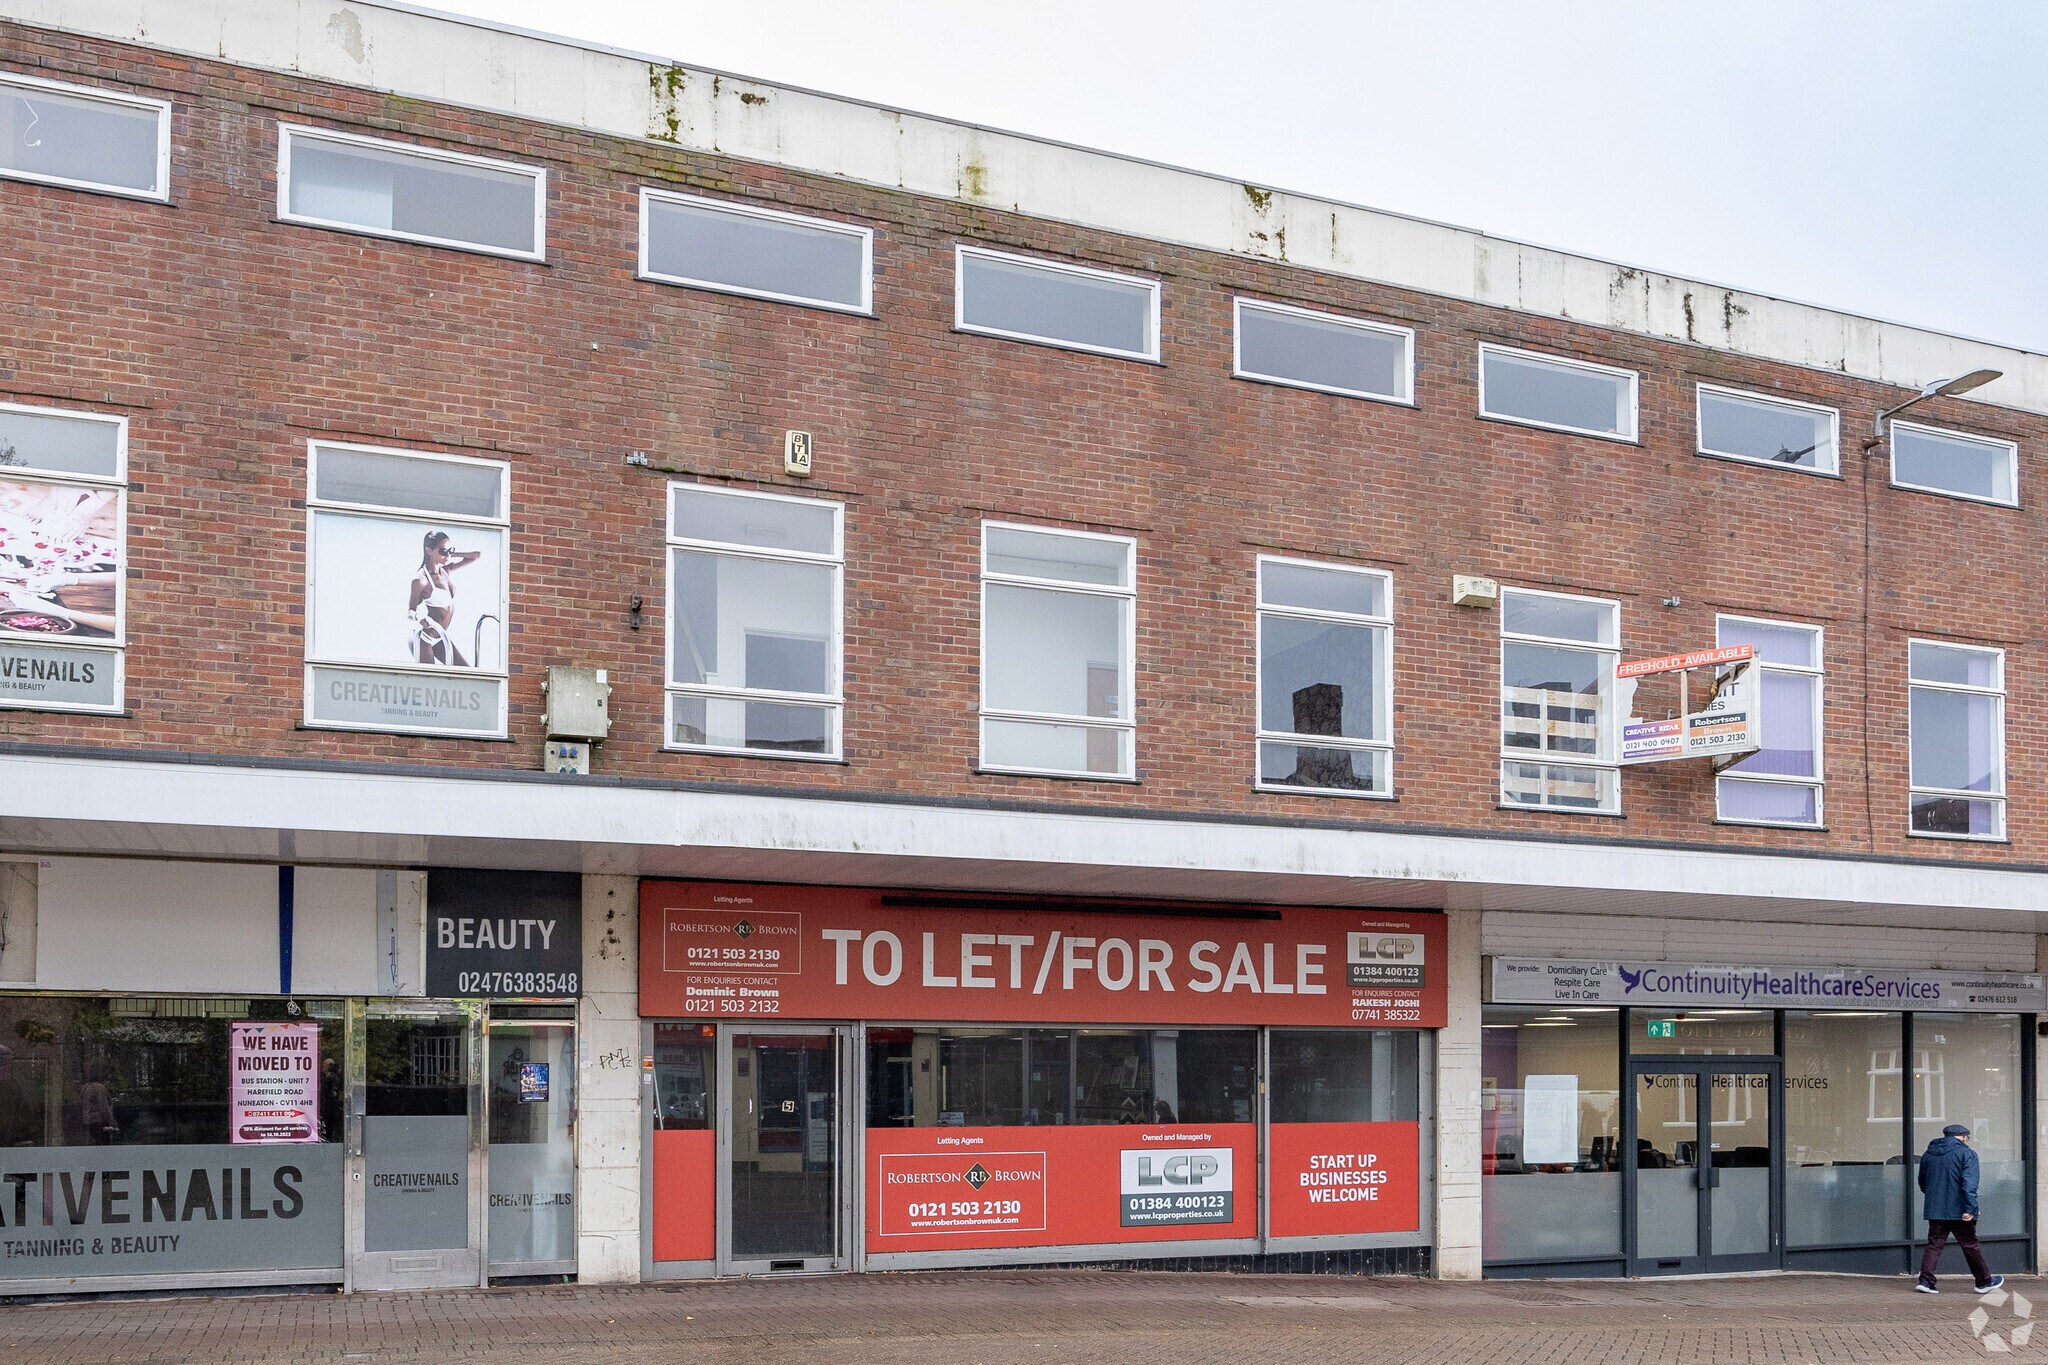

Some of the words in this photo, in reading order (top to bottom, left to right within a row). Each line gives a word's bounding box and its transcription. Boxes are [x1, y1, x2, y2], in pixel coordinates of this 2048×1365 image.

[1619, 657, 1680, 675] FREEHOLD
[1684, 646, 1750, 666] AVAILABLE
[18, 682, 46, 691] BEAUTY
[1717, 682, 1739, 697] IT
[1705, 700, 1725, 712] IES
[381, 707, 408, 716] TANNING
[415, 709, 439, 718] BEAUTY
[1694, 715, 1741, 726] Robertson
[1625, 726, 1656, 736] CREATIVE
[1658, 723, 1680, 732] RETAIL
[1704, 726, 1732, 734] Brown
[1626, 742, 1640, 750] 0121
[1660, 738, 1680, 746] 0407
[1690, 737, 1706, 746] 0121
[1709, 735, 1724, 744] 503
[1727, 733, 1746, 742] 2130
[713, 896, 733, 904] Letting
[734, 896, 753, 904] Agents
[437, 917, 557, 950] BEAUTY
[670, 922, 731, 933] ROBERTSON
[759, 925, 798, 935] BROWN
[687, 947, 718, 959] 0121
[722, 948, 746, 960] 503
[749, 949, 780, 960] 2130
[1359, 936, 1415, 960] LCP
[688, 960, 779, 968] www.robertsonbrownuk.com
[821, 928, 902, 987] TO
[1188, 942, 1327, 994] SALE
[1353, 966, 1382, 976] 01384
[1384, 967, 1419, 976] 400123
[1506, 964, 1516, 972] We
[1517, 965, 1542, 973] provide:
[1548, 966, 1588, 976] Domiciliary
[1590, 966, 1608, 976] Care
[458, 972, 579, 994] 02476383548
[686, 976, 702, 984] FOR
[704, 976, 742, 985] ENQUIRIES
[743, 977, 778, 986] CONTACT
[1353, 976, 1418, 984] www.lcpproperties.co.uk
[1554, 978, 1582, 988] Respite
[1584, 978, 1600, 988] Care
[686, 986, 736, 997] Dominic
[739, 987, 780, 998] Brown
[1555, 990, 1570, 998] Live
[1572, 990, 1580, 998] In
[1582, 990, 1600, 999] Care
[685, 1000, 715, 1012] 0121
[720, 1000, 744, 1012] 503
[748, 1000, 780, 1012] 2132
[1352, 998, 1391, 1007] RAKESH
[1394, 999, 1420, 1008] JOSHI
[1352, 1009, 1380, 1020] 07741
[1384, 1010, 1420, 1020] 385322
[242, 1036, 266, 1050] WE
[272, 1036, 308, 1051] HAVE
[238, 1056, 290, 1071] MOVED
[294, 1056, 312, 1071] TO
[247, 1088, 282, 1096] HAREFIELD
[937, 1136, 960, 1145] Letting
[960, 1136, 984, 1145] Agents
[1176, 1133, 1204, 1142] Managed
[1204, 1133, 1212, 1142] by
[1309, 1154, 1354, 1170] START
[1357, 1153, 1377, 1168] UP
[1138, 1155, 1218, 1186] LCP
[887, 1172, 961, 1184] ROBERTSON
[995, 1170, 1041, 1182] BROWN
[1300, 1170, 1388, 1186] BUSINESSES
[1308, 1186, 1378, 1203] WELCOME
[908, 1202, 947, 1217] 0121
[951, 1202, 980, 1216] 503
[983, 1200, 1022, 1214] 2130
[1130, 1198, 1172, 1211] 01384
[1175, 1196, 1225, 1209] 400123
[1130, 1210, 1224, 1220] www.lcpproperties.co.uk
[911, 1218, 1019, 1227] www.robertsonbrownuk.com
[4, 1238, 85, 1258] TANNING
[91, 1238, 104, 1255] &
[110, 1235, 181, 1255] BEAUTY
